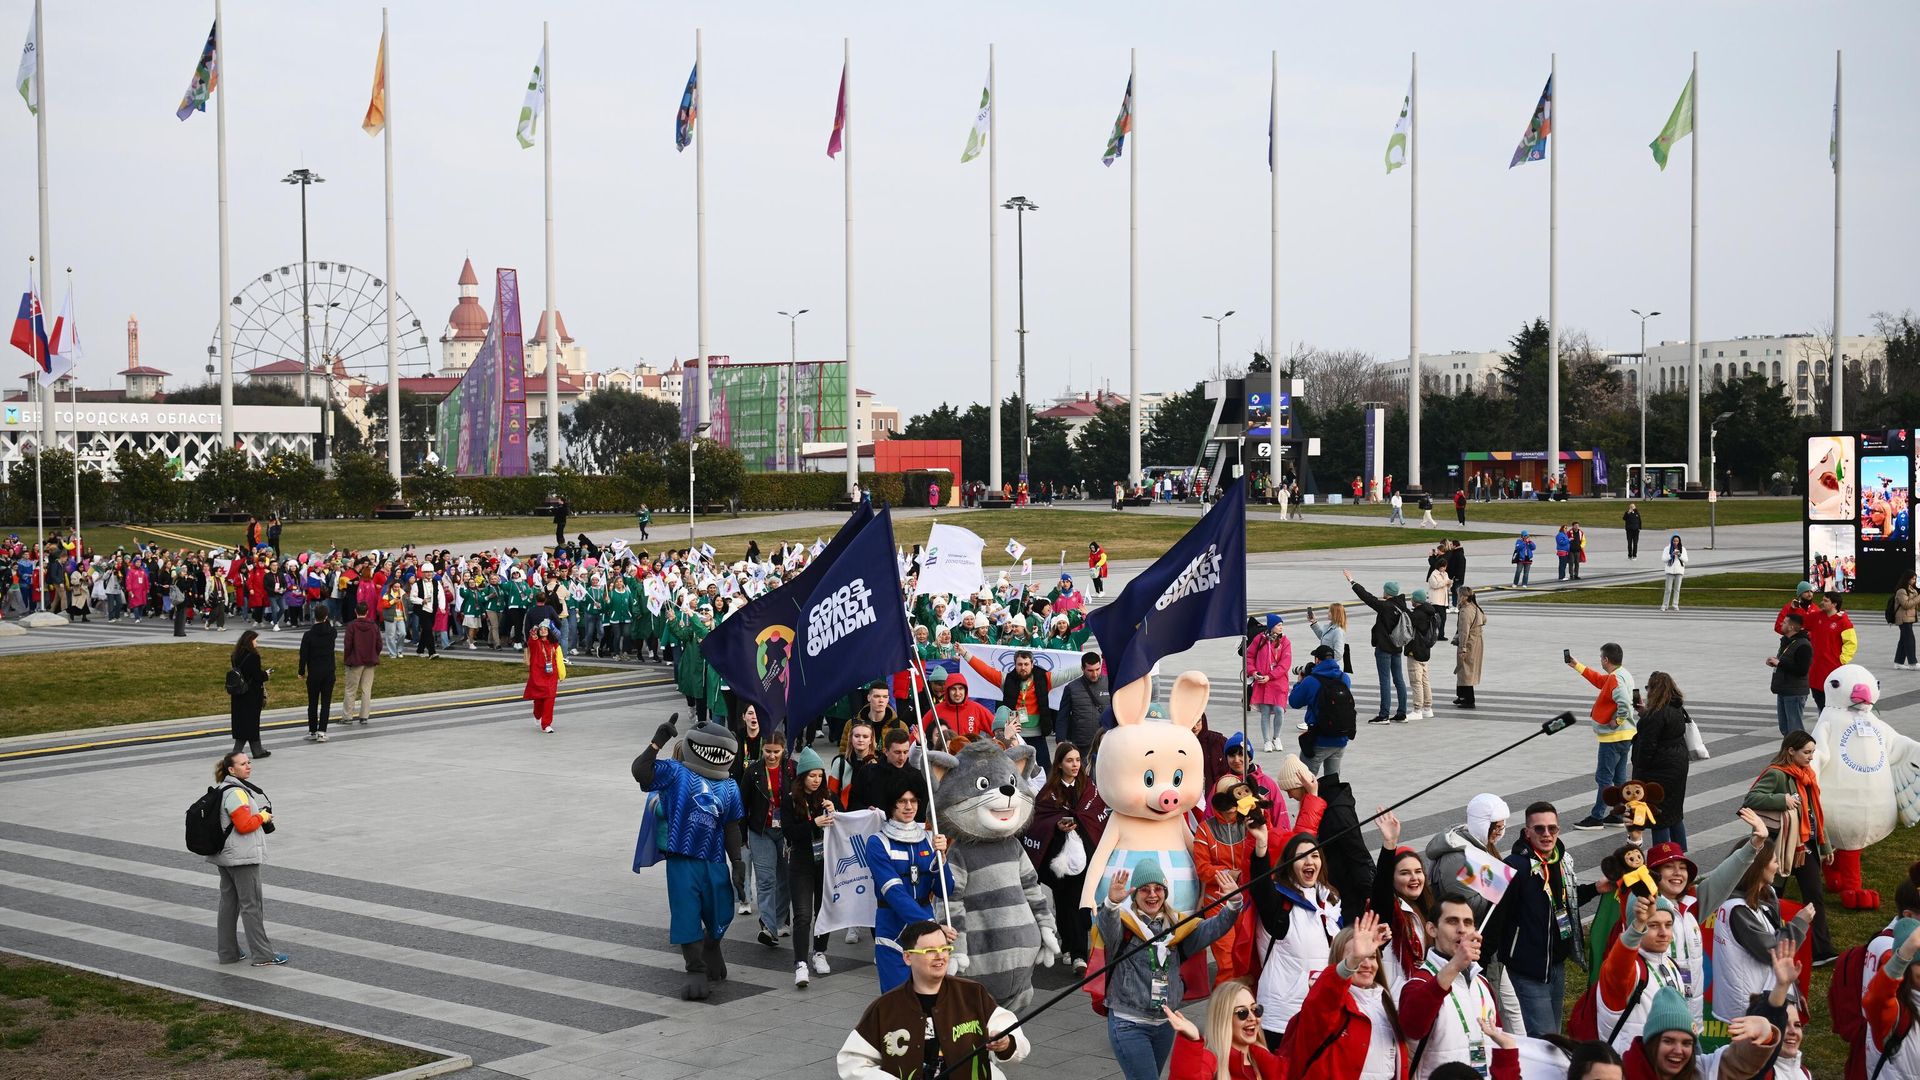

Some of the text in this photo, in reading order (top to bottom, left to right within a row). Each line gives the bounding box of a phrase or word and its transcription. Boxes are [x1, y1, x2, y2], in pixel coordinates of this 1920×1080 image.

[22, 411, 149, 426] БЕГОРОДСКАЯ
[808, 589, 872, 640] МУЛЬТ
[809, 578, 865, 623] СОЮЗ
[806, 606, 877, 656] ФИЛЬМ
[833, 876, 868, 890] АССОЦИАЦИЯ
